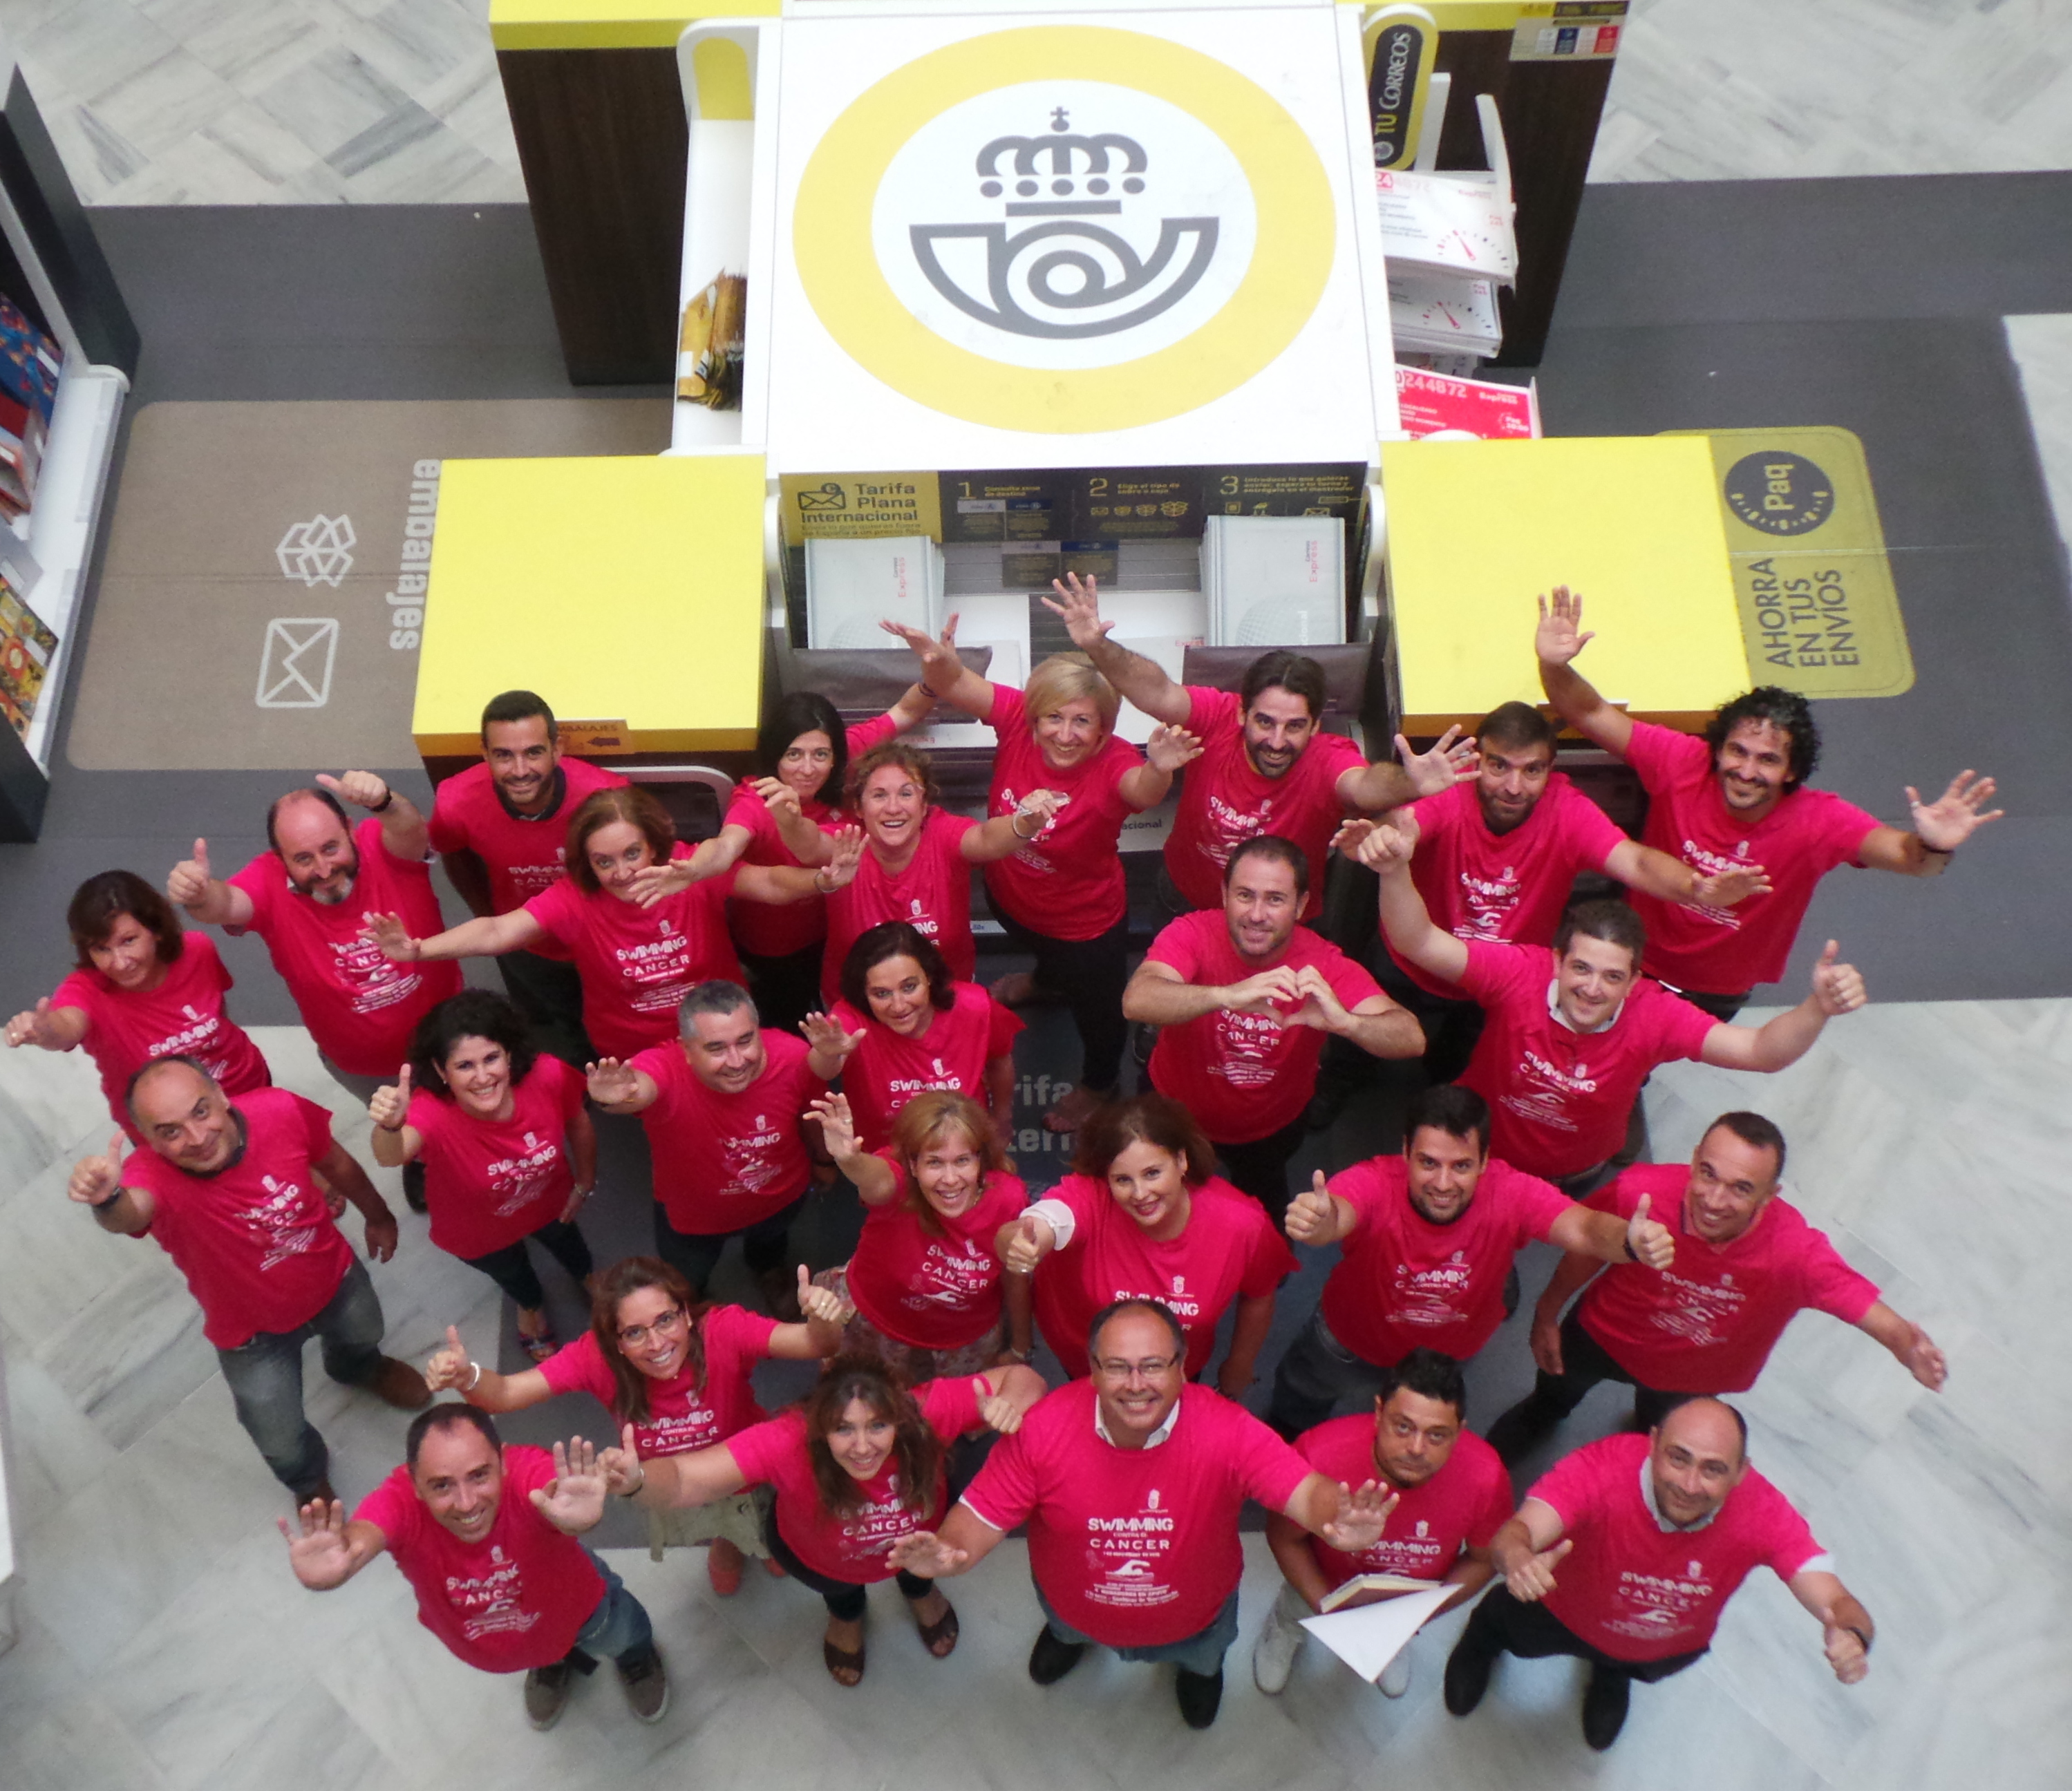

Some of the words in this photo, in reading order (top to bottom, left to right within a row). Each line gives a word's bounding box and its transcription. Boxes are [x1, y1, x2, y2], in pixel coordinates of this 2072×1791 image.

[1379, 32, 1411, 110] CORREOS
[1375, 114, 1398, 135] TU
[855, 483, 916, 495] Tarifa
[958, 482, 977, 500] 1
[1089, 477, 1108, 497] 2
[1220, 475, 1239, 495] 3
[1763, 463, 1795, 511] Paq
[858, 497, 916, 509] Plana
[802, 510, 919, 523] Internacional
[386, 459, 442, 650] embalajes
[1310, 540, 1319, 582] Express
[898, 557, 907, 598] Express
[1748, 558, 1796, 668] AHORRA
[1784, 578, 1818, 625] TUS
[1793, 632, 1828, 667] EN
[1122, 819, 1162, 829] acional
[616, 936, 688, 960] SWIMMING
[623, 954, 690, 976] CANCER
[890, 1077, 961, 1092] SWIMMING
[922, 1262, 988, 1289] CANCER
[641, 1425, 718, 1448] CANCER
[842, 1511, 922, 1536] CANCER
[1088, 1517, 1174, 1531] SWIMMING
[1090, 1538, 1170, 1550] CANCER
[1621, 1571, 1713, 1598] SWIMMING
